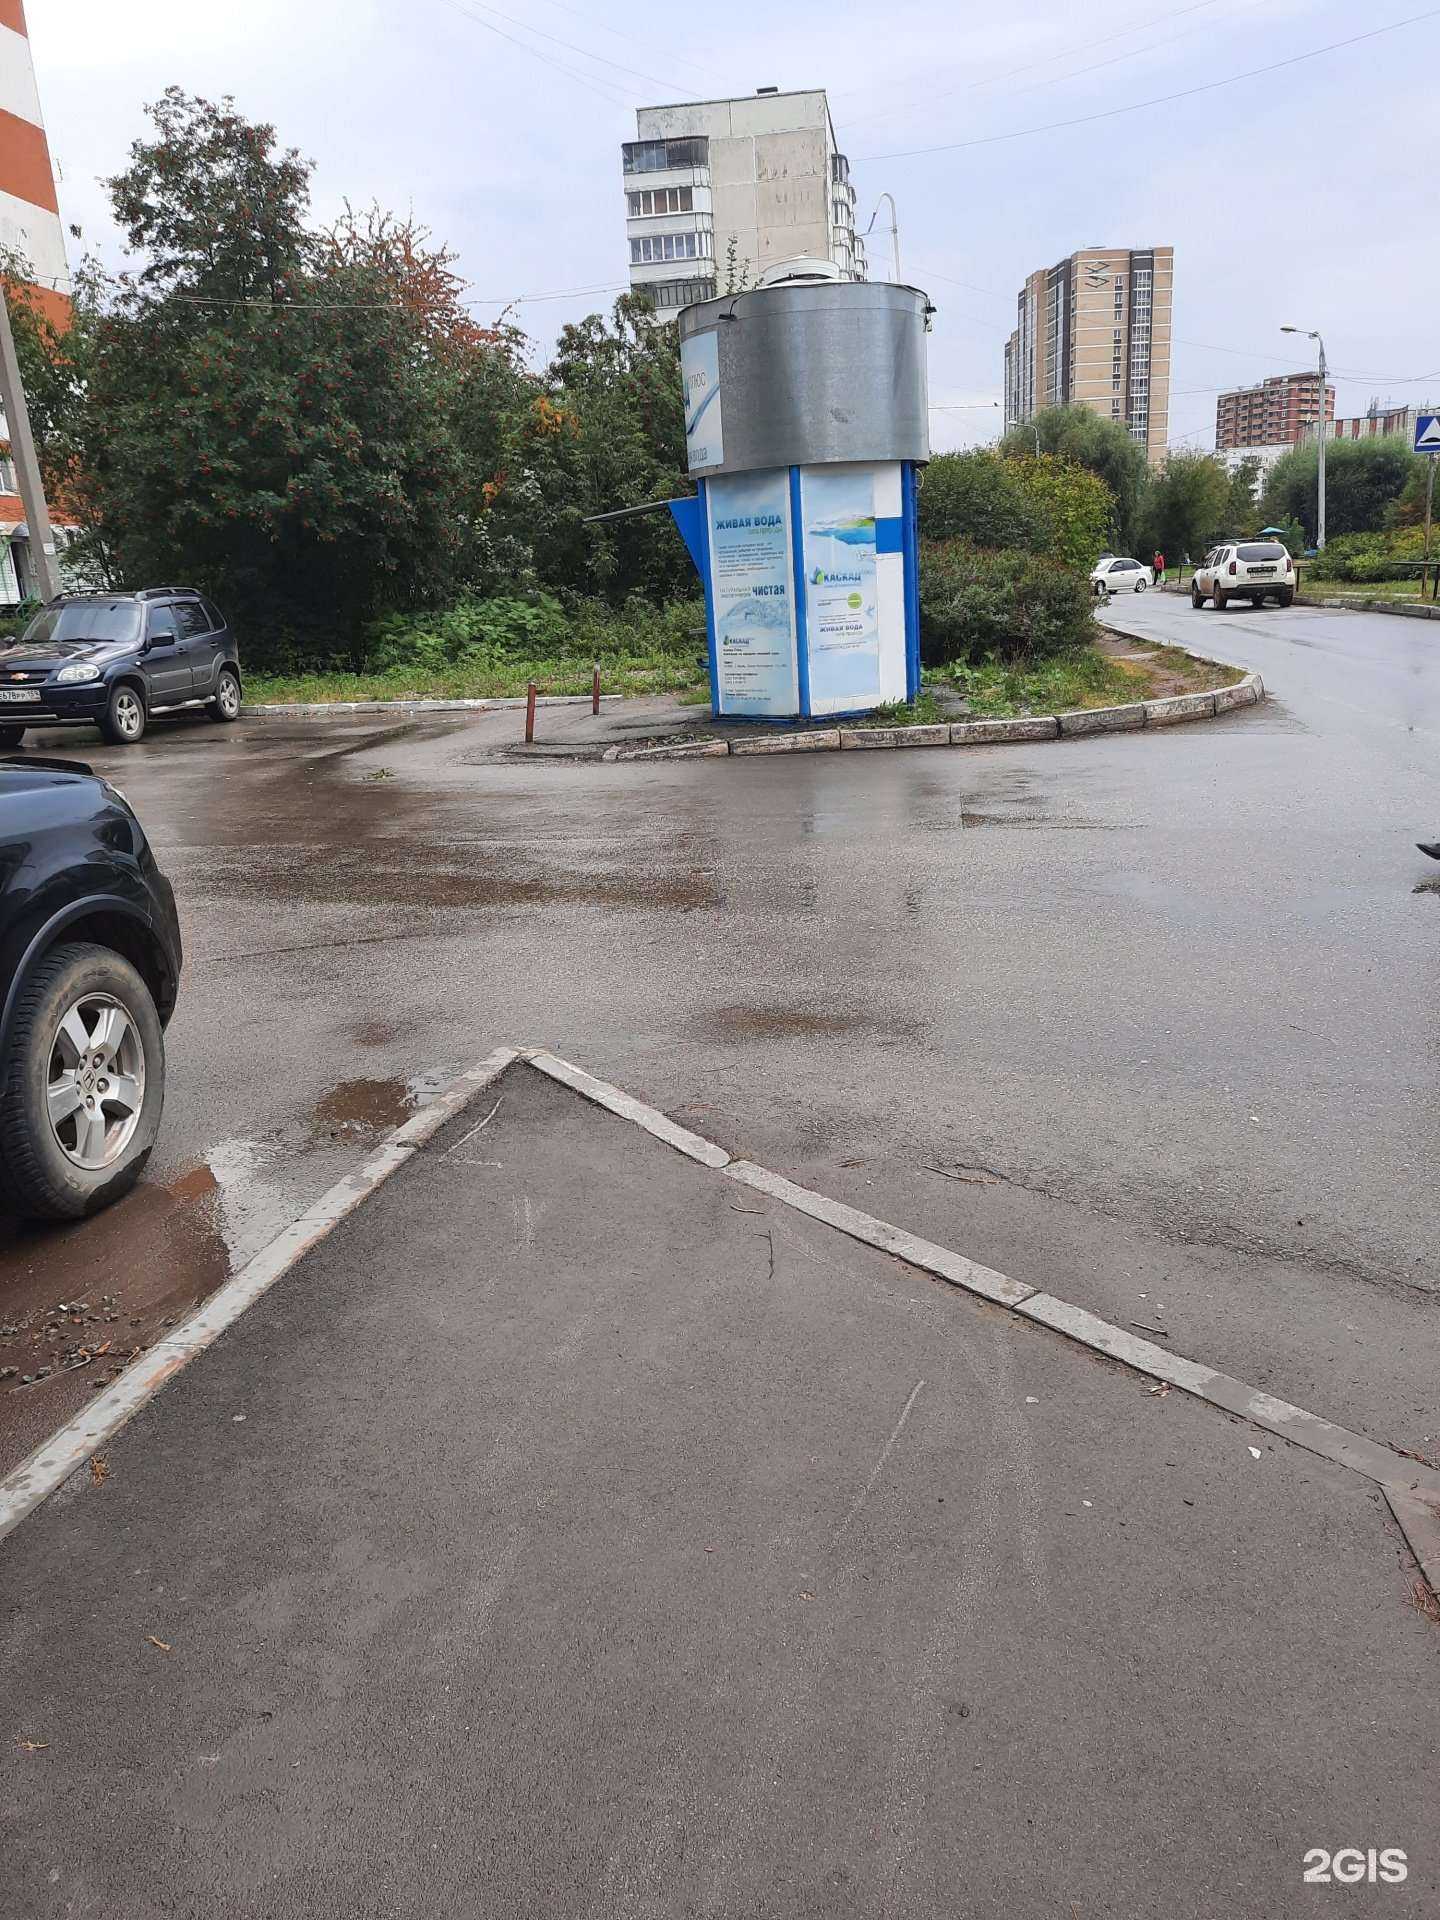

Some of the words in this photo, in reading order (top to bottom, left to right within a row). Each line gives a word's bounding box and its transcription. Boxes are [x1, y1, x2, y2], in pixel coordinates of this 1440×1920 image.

[716, 517, 752, 530] ЖИВАЯ
[754, 514, 782, 527] ВОДА
[845, 623, 864, 631] ВОДА
